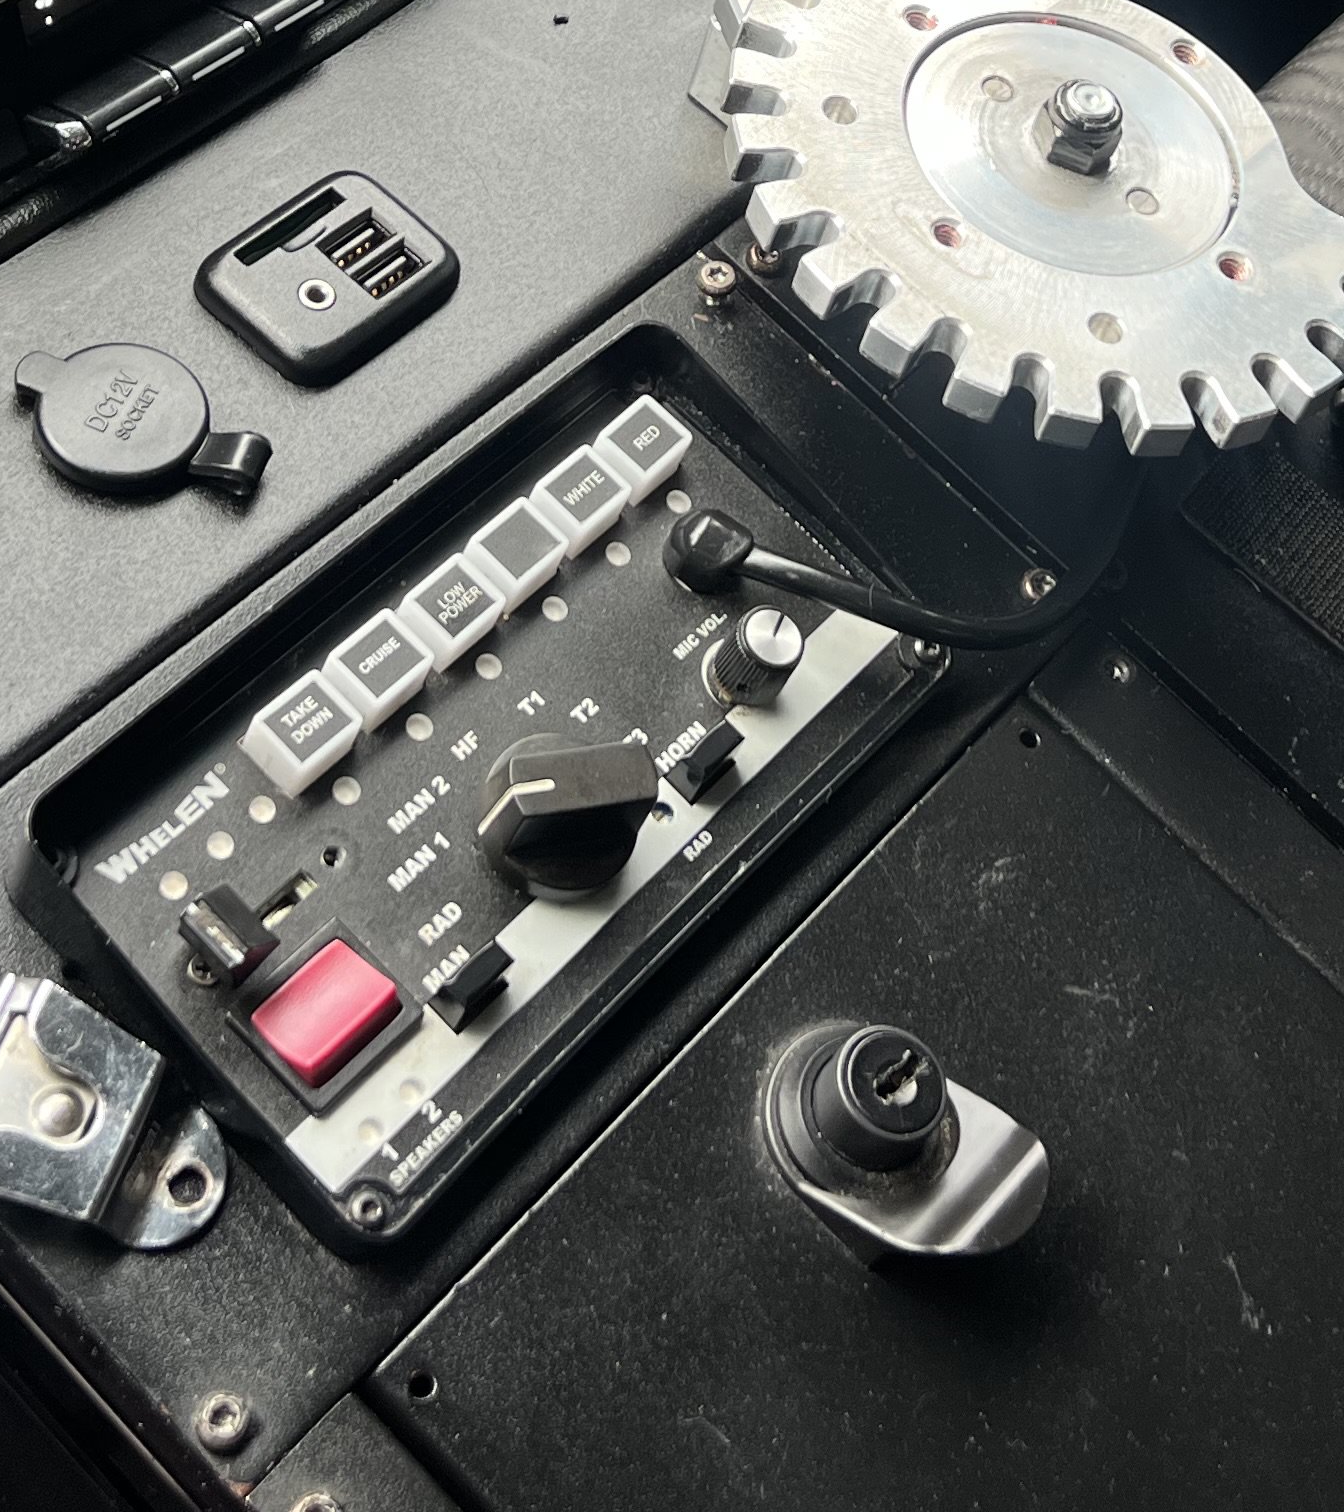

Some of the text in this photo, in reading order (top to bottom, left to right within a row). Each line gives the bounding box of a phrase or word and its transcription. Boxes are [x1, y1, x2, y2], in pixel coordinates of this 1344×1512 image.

[84, 369, 139, 433] DC12V
[115, 384, 160, 441] SOCKET
[632, 425, 661, 452] RED
[562, 469, 606, 507] WHITE
[436, 581, 466, 609] LOW
[437, 585, 484, 625] POWER
[357, 635, 401, 675] CRUISE
[672, 613, 728, 661] MIC VOL.
[280, 695, 319, 729] TAKE
[517, 689, 547, 716] T1
[569, 697, 600, 723] T2
[290, 706, 334, 745] DOWN
[449, 730, 479, 762] HF
[654, 720, 707, 774] HORN
[386, 774, 452, 835] MAN 2
[94, 770, 230, 885] WHELEN
[682, 830, 713, 863] RAD
[386, 831, 451, 893] MAN 1
[417, 901, 464, 947] RAD
[421, 944, 471, 994] MAN
[420, 1099, 443, 1125] 2
[380, 1141, 400, 1162] 1
[389, 1110, 464, 1187] SPEAKERS
